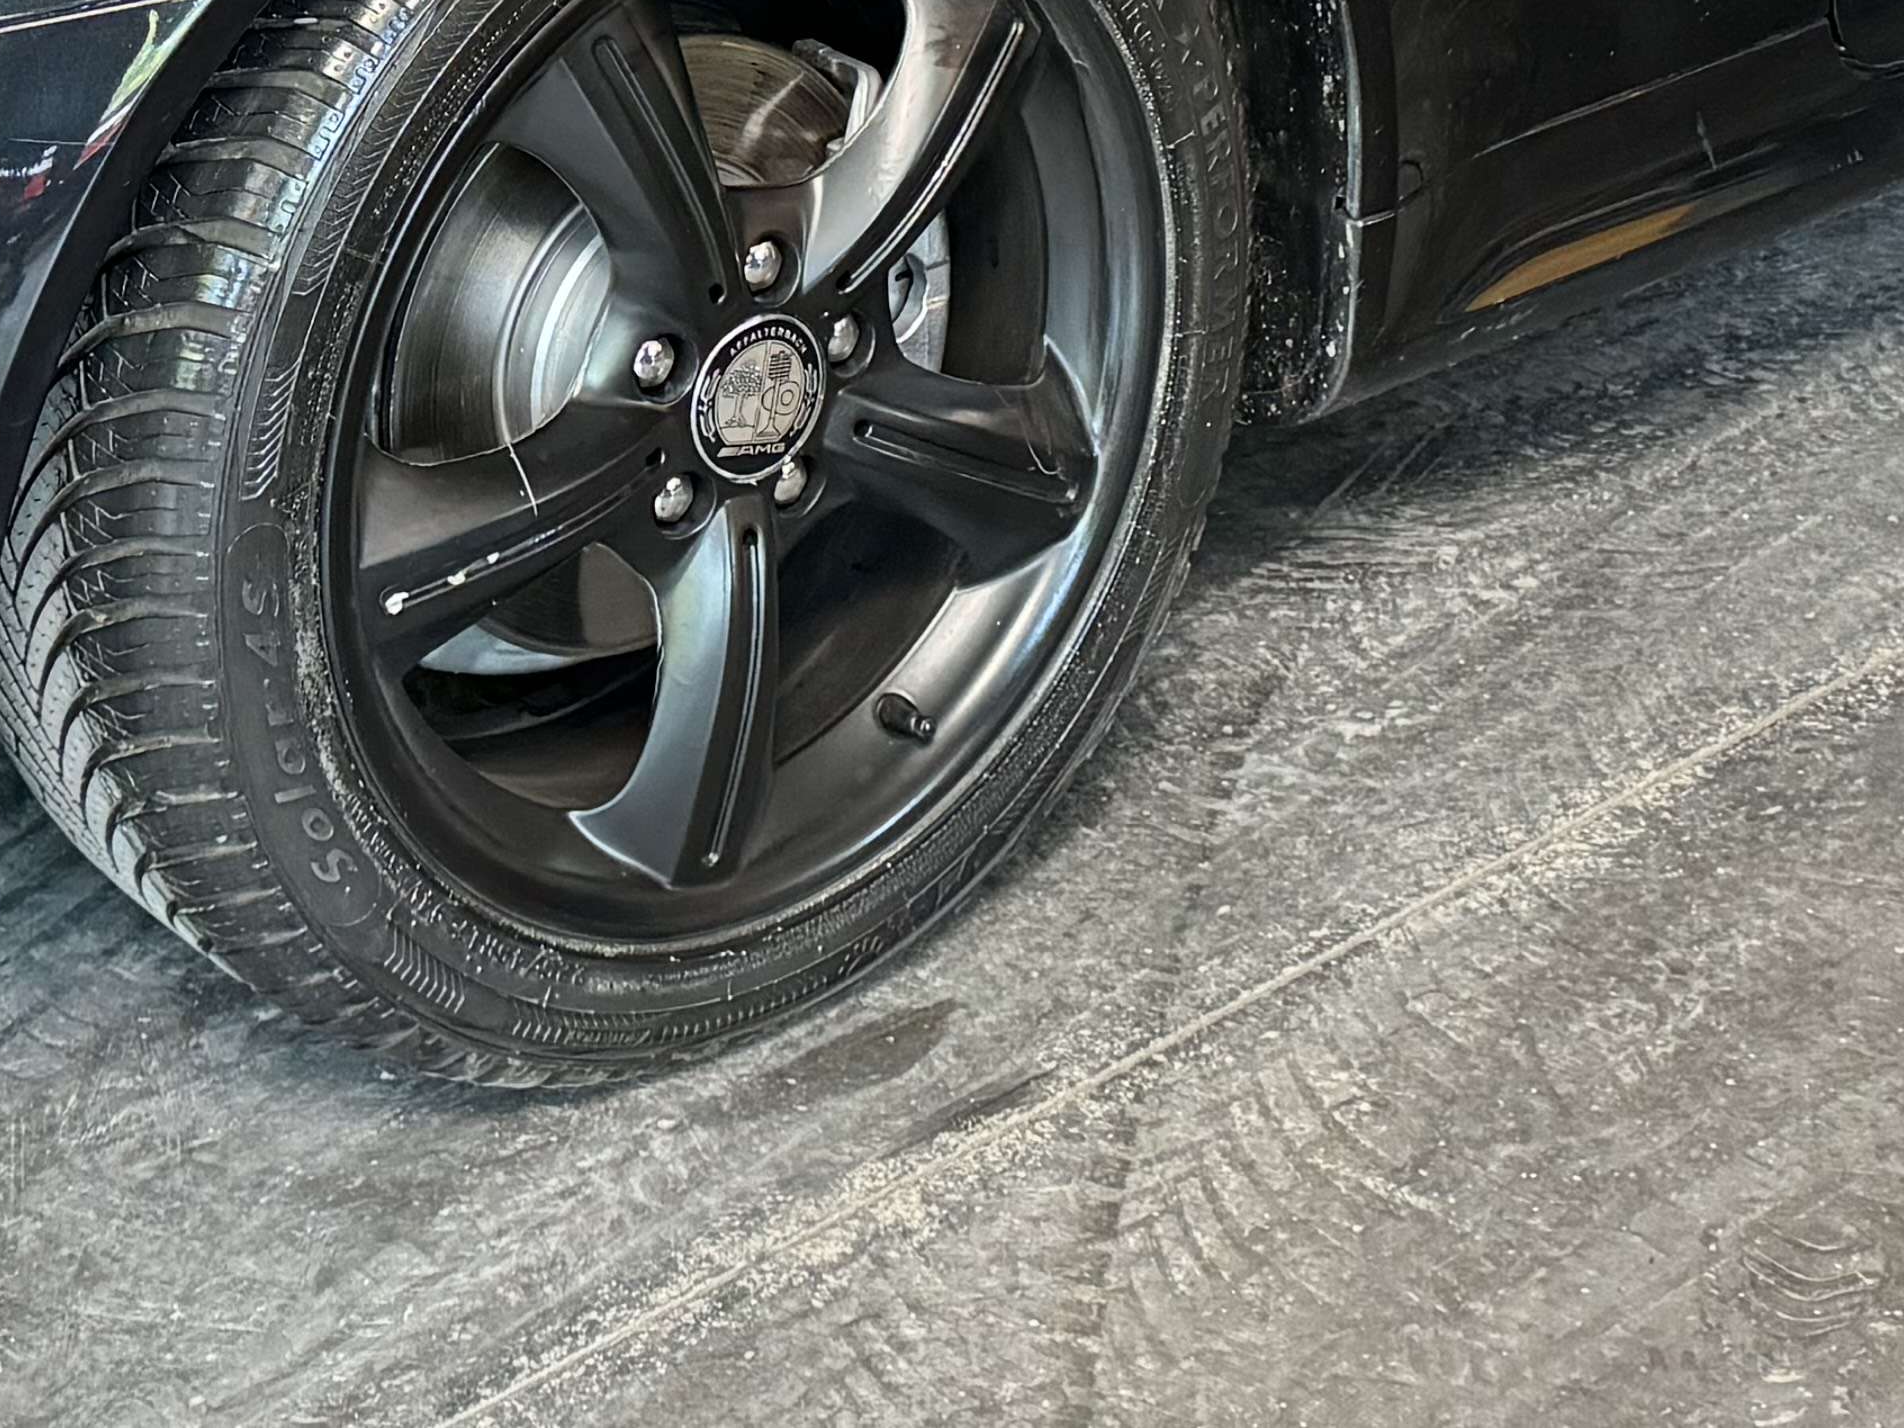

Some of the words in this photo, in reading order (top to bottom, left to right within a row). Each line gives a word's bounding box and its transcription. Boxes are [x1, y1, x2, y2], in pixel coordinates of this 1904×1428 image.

[1192, 78, 1240, 402] PERFORMER
[729, 326, 809, 357] AFFALTERBACH
[737, 444, 786, 456] AMG
